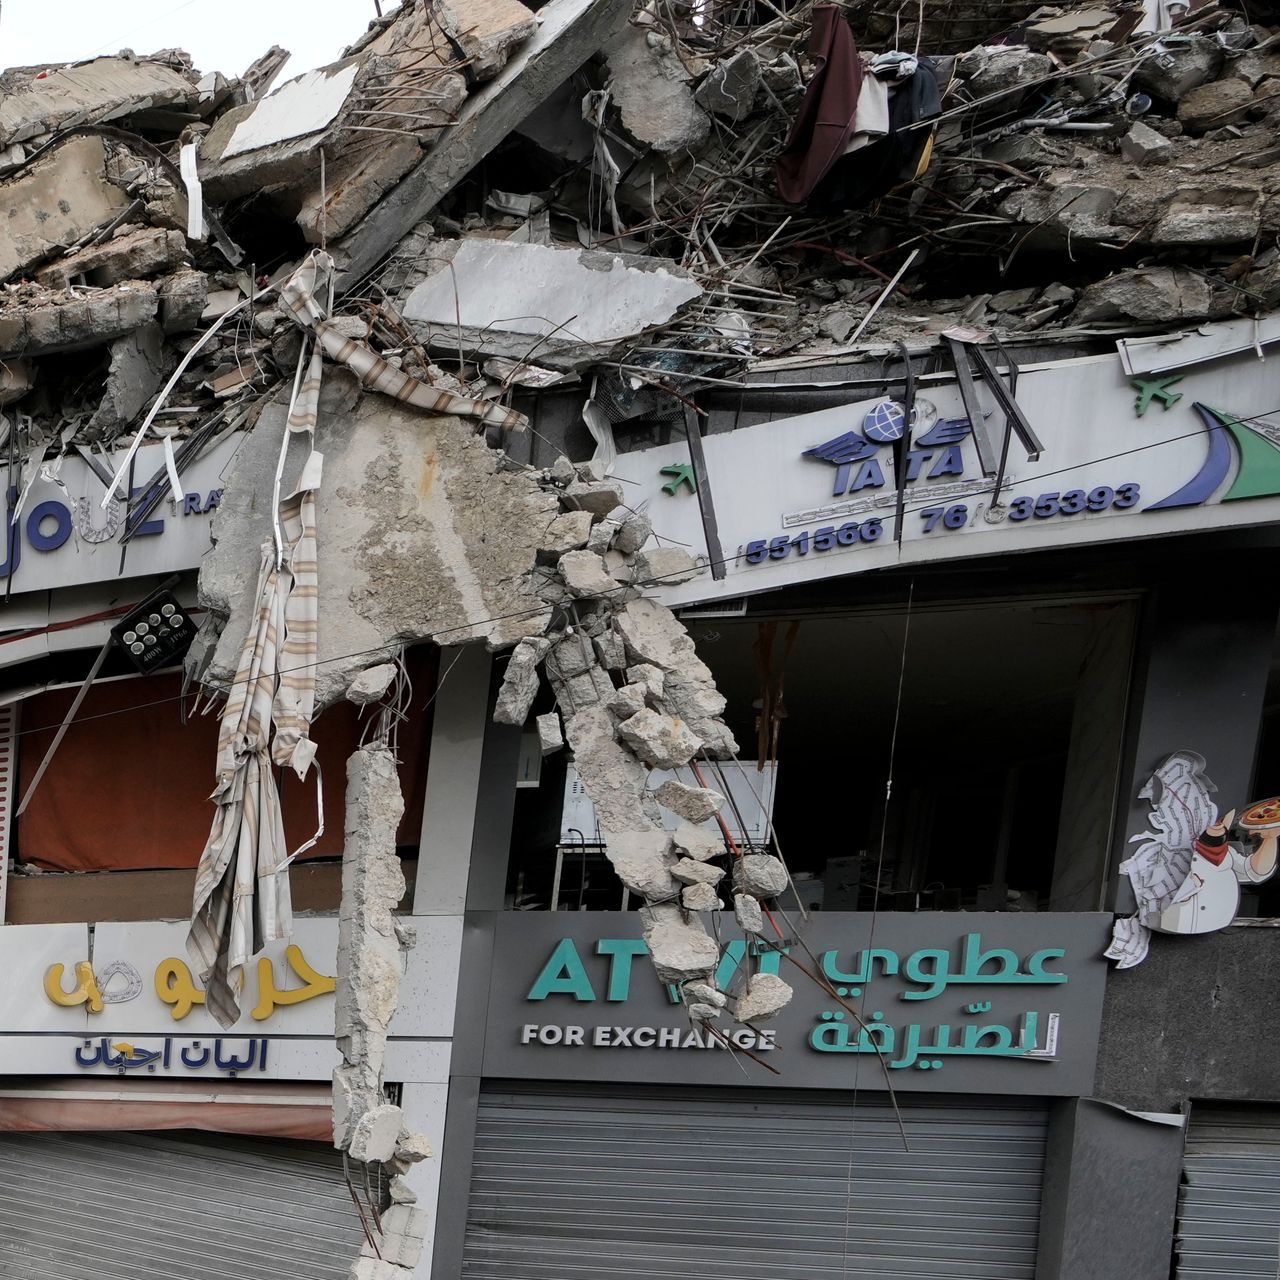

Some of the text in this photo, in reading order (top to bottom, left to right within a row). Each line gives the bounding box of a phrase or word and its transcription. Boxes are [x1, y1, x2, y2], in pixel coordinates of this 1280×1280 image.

[832, 445, 963, 497] IATA
[822, 932, 1069, 1001] عطوي
[520, 1024, 776, 1050] FOR EXCHANGE
